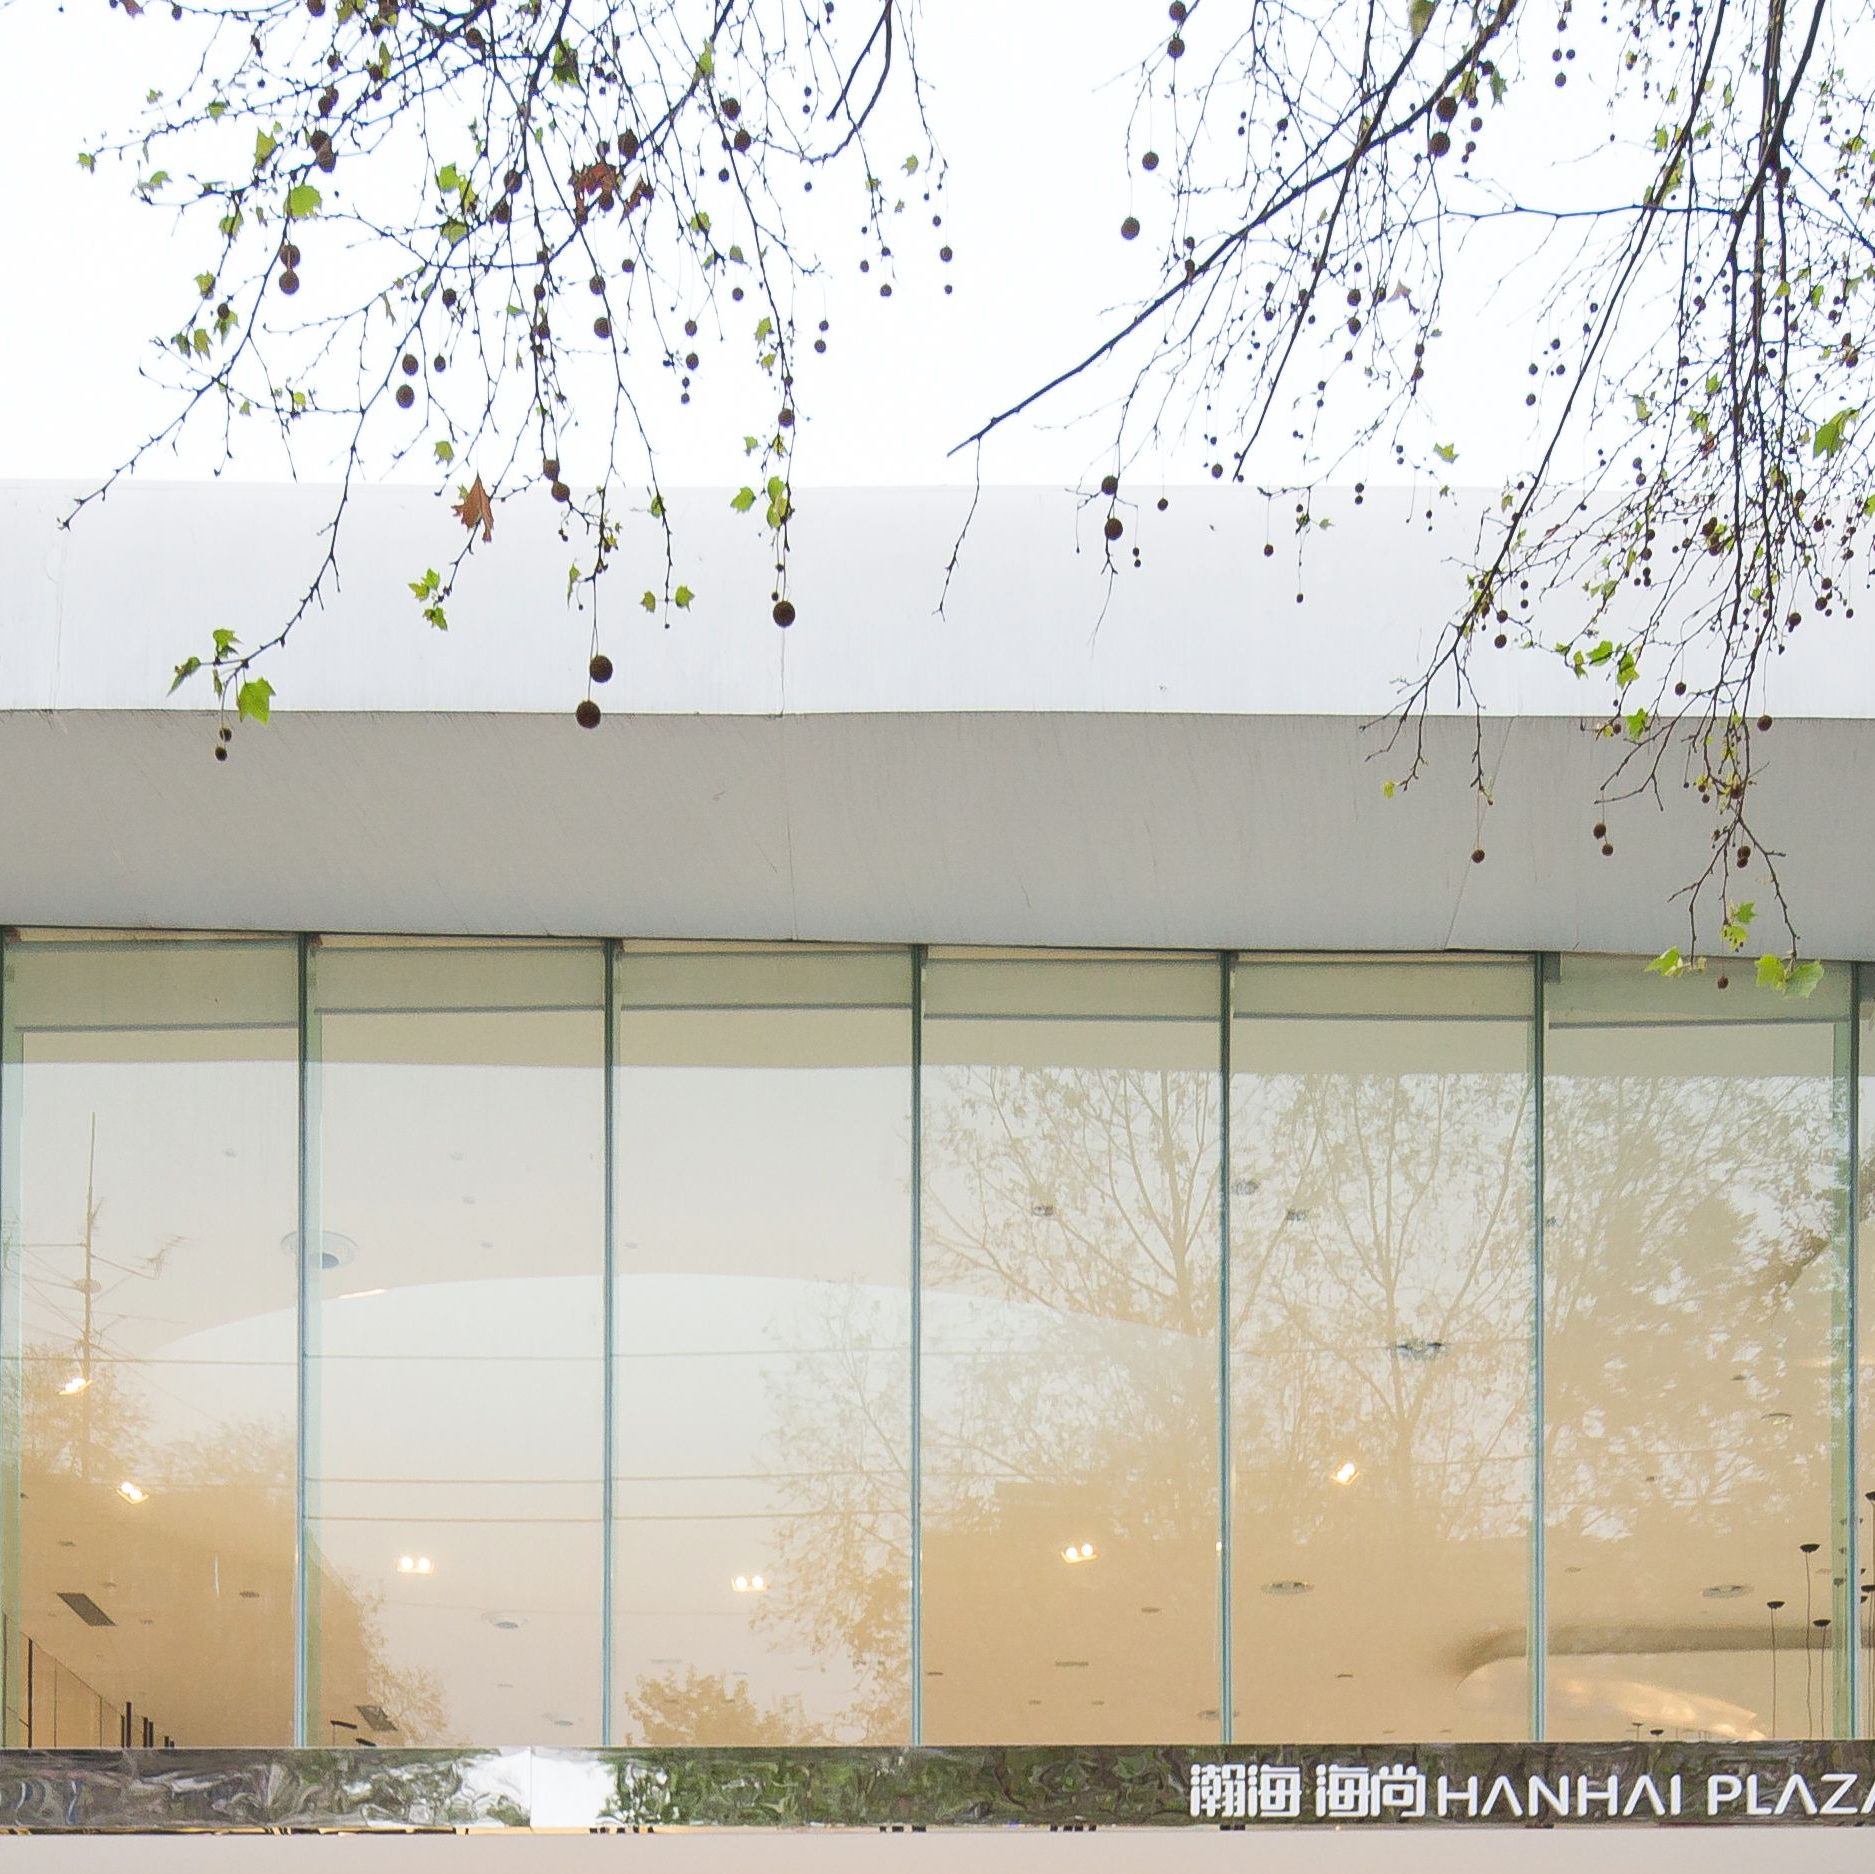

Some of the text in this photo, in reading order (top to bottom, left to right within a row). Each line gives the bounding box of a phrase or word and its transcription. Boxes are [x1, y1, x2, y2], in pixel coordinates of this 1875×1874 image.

[1190, 1763, 1302, 1818] 瀚海
[1315, 1763, 1427, 1818] 海尚
[1437, 1774, 1682, 1818] HANHAI
